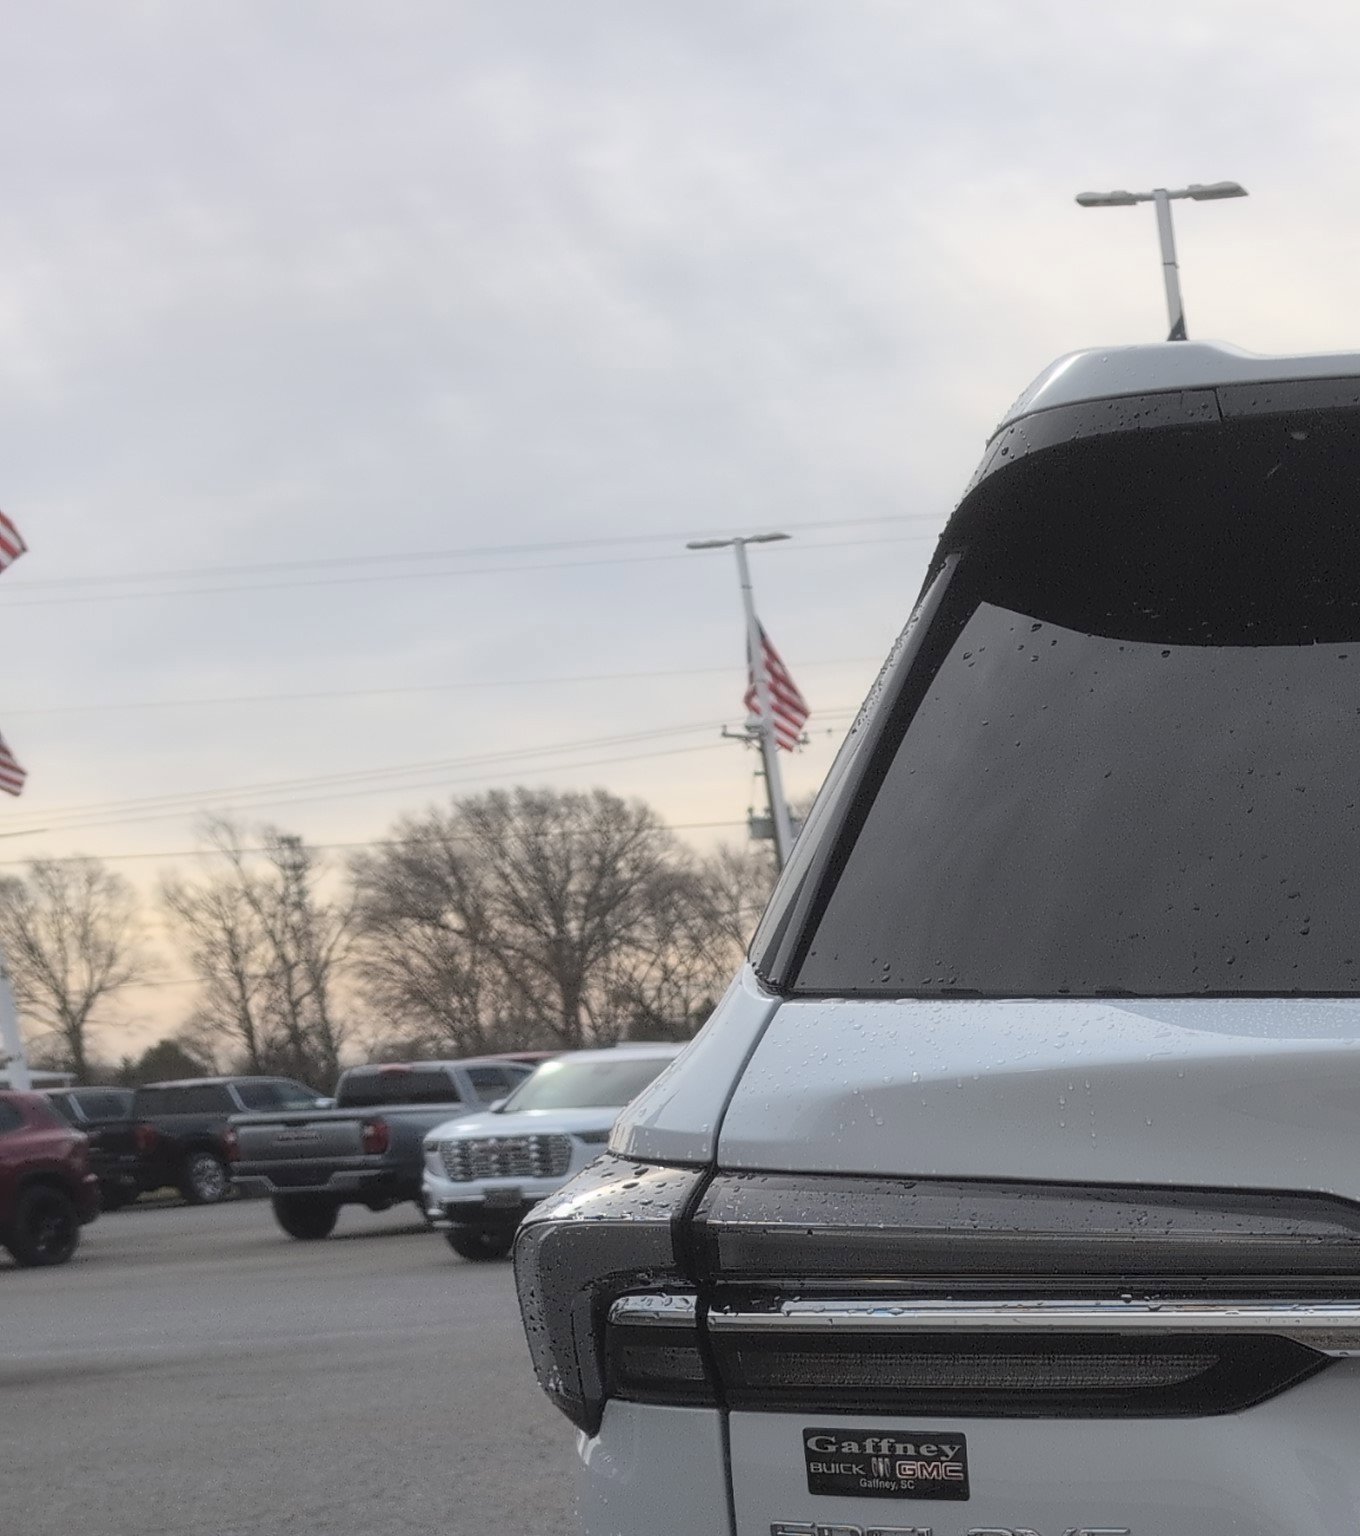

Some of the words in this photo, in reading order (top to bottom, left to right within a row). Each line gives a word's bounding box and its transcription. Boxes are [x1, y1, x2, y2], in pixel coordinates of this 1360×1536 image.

[806, 1435, 962, 1461] Gaffney
[810, 1461, 867, 1476] BUICK
[896, 1460, 965, 1481] GMC
[859, 1477, 899, 1491] Gaffney,
[900, 1479, 915, 1490] SC
